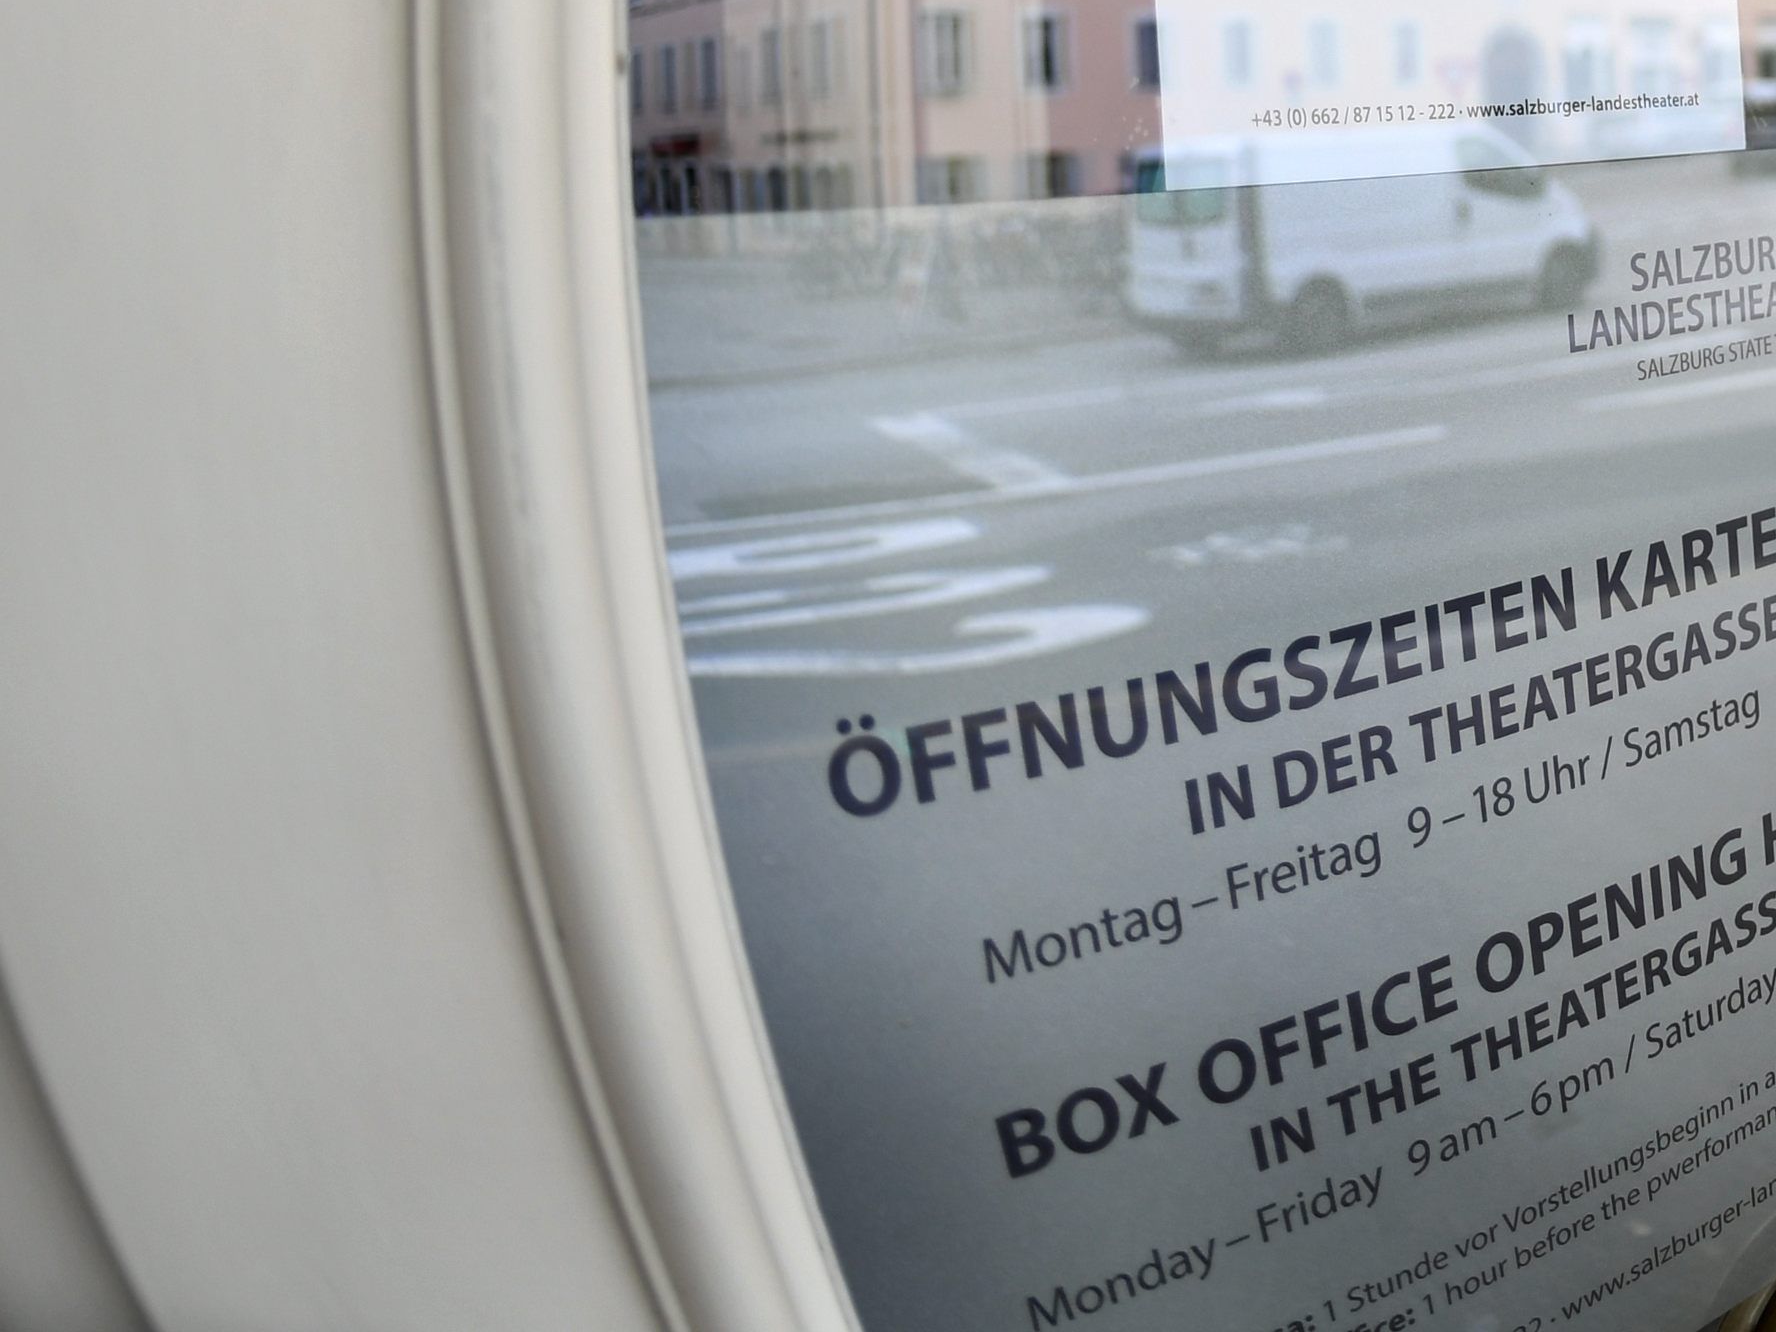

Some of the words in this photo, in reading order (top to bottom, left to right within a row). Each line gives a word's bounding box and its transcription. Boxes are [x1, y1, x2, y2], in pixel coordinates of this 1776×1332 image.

[1251, 109, 1282, 127] +43
[1287, 107, 1307, 129] (0)
[1311, 107, 1340, 125] 662
[1428, 103, 1455, 120] 222
[1466, 92, 1700, 118] www.salzburger-landestheater.at
[1637, 343, 1725, 382] SALZBURG
[1728, 335, 1773, 363] STATE
[828, 566, 1578, 819] ÖFFNUNGSZEITEN
[1523, 754, 1590, 805] Uhr
[1601, 735, 1613, 780] /
[1623, 689, 1760, 769] Samstag
[1185, 763, 1257, 836] IN
[1274, 727, 1397, 813] DER
[992, 1061, 1180, 1179] BOX
[1197, 955, 1464, 1106] OFFICE
[1474, 829, 1751, 993] OPENING
[1250, 1114, 1316, 1172] IN
[1327, 1071, 1441, 1138] THE
[1323, 1299, 1336, 1321] 1
[1347, 1251, 1448, 1313] Stunde
[1455, 1223, 1498, 1258] vor
[1502, 1093, 1735, 1233] Vorstellungsbeginn
[1738, 1077, 1759, 1105] in
[1423, 1294, 1435, 1315] 1
[1445, 1258, 1507, 1305] hour
[1514, 1218, 1596, 1270] before
[1601, 1186, 1641, 1220] the
